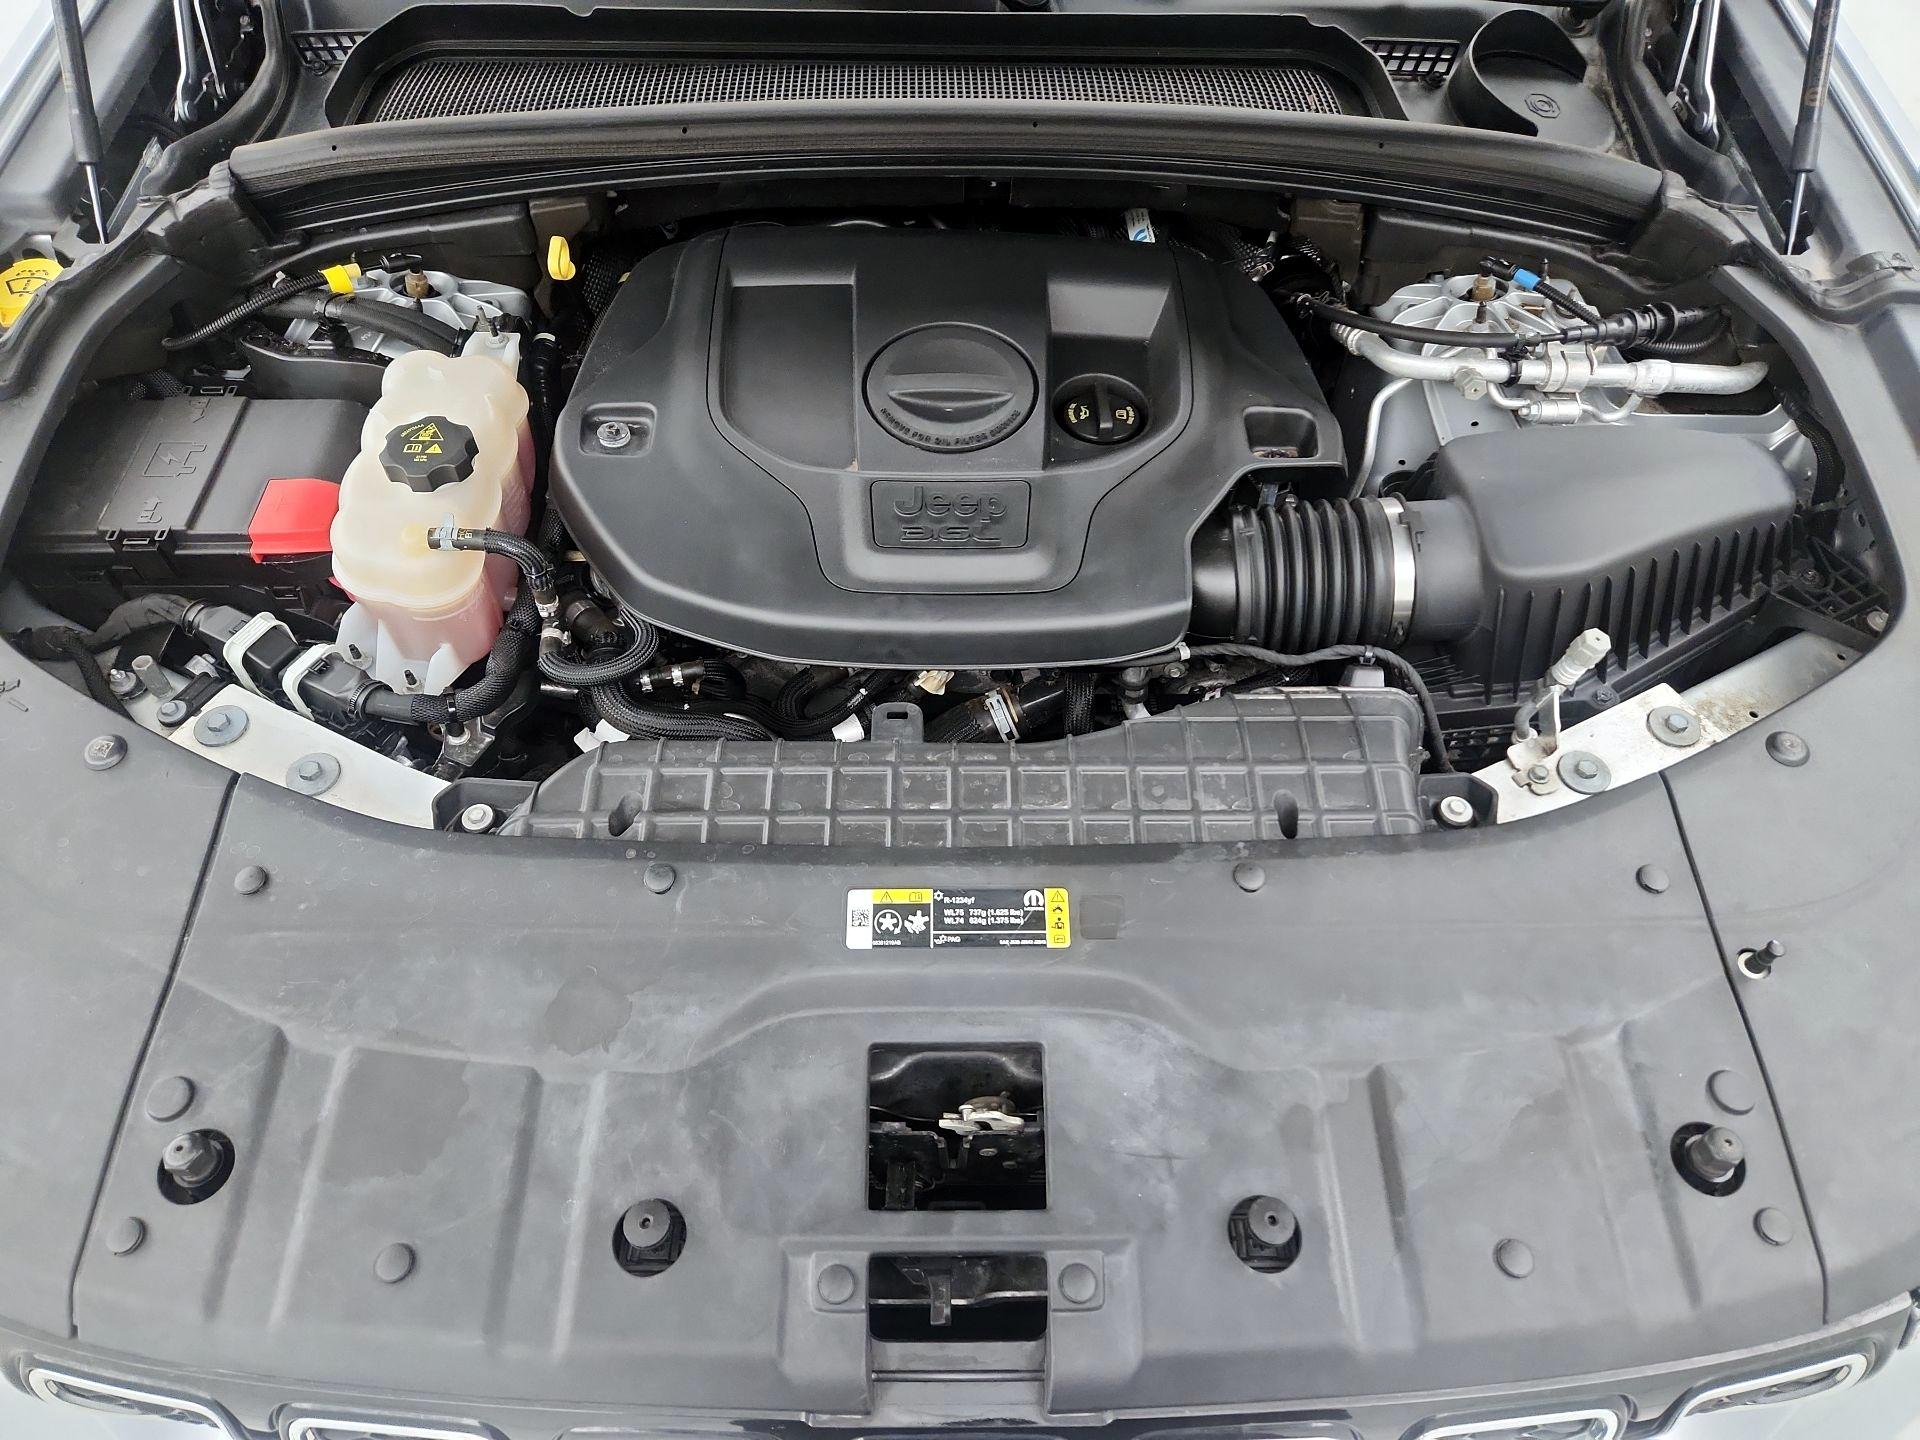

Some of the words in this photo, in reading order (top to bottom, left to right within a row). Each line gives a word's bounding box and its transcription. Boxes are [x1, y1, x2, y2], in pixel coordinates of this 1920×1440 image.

[912, 431, 932, 443] FOR
[934, 437, 951, 446] OIL
[953, 432, 988, 446] FILTER
[894, 486, 1007, 523] Jeep
[900, 525, 1001, 542] 3.6L
[943, 896, 976, 905] R-1234yf
[943, 908, 965, 916] WL75
[968, 908, 987, 917] 737g
[987, 908, 1009, 917] (1.625
[1009, 908, 1024, 917] lbs)
[943, 917, 965, 925] WL74
[987, 917, 1009, 926] (1.375
[1009, 917, 1024, 926] lbs)
